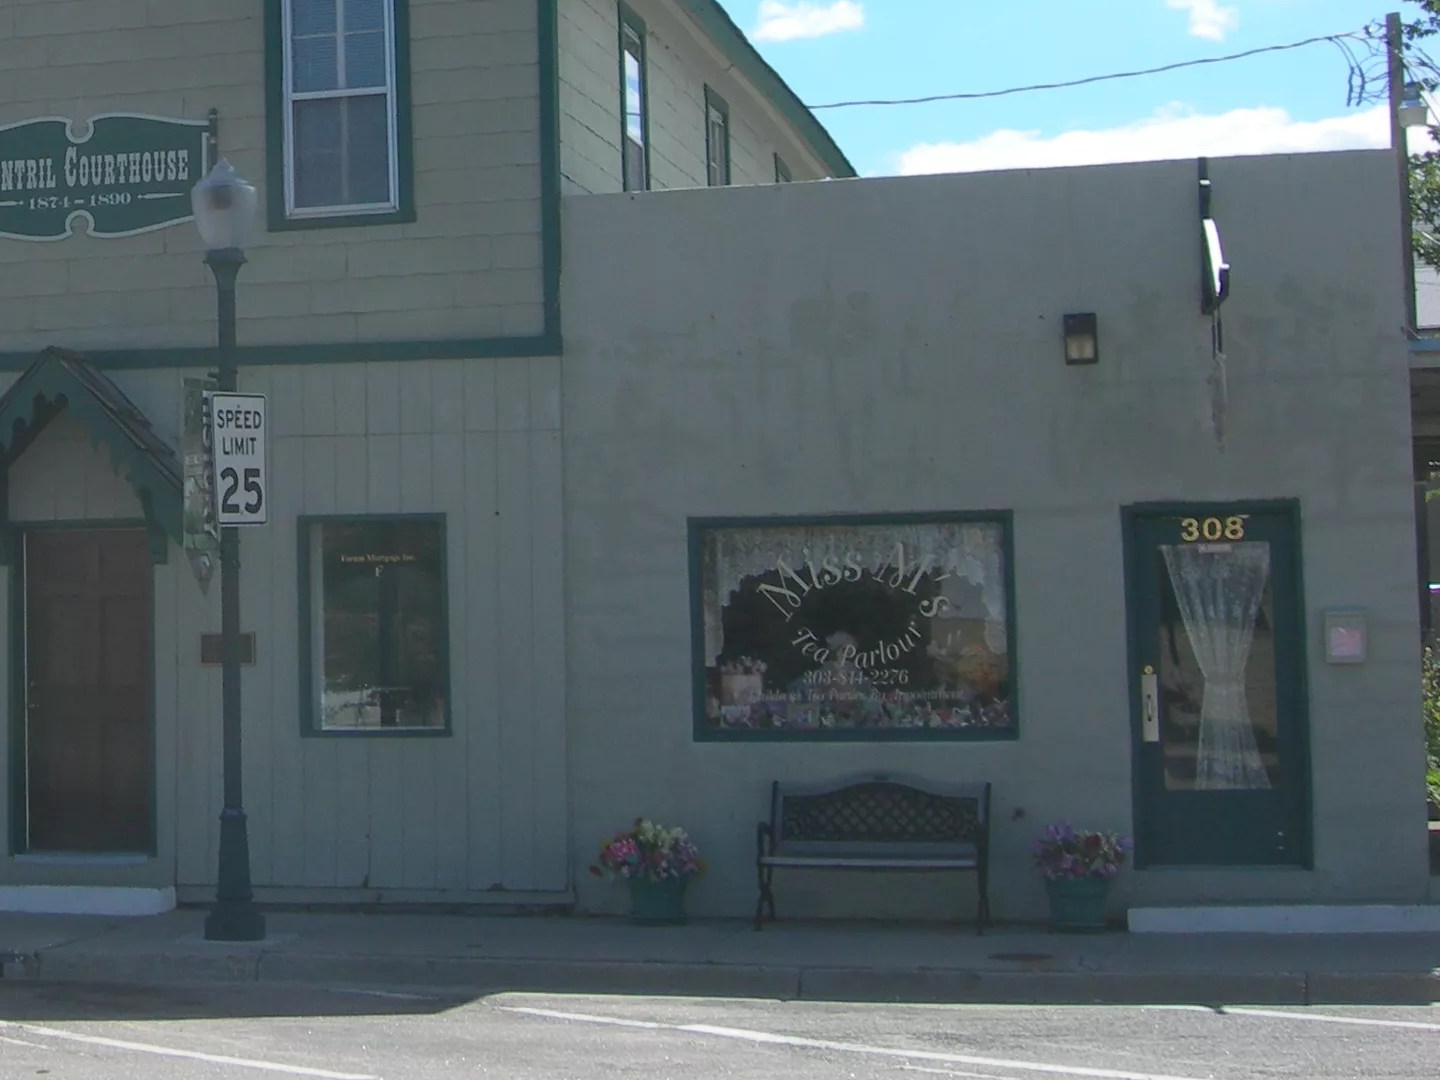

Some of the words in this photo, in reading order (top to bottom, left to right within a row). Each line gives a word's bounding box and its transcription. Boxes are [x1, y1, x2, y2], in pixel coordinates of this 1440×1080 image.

[64, 146, 189, 188] COURTHOUSE
[89, 191, 132, 207] 1890
[217, 410, 262, 428] SPEED
[223, 438, 256, 455] LIMIT
[220, 466, 263, 515] 25
[1180, 516, 1245, 542] 308
[756, 547, 862, 623] Miss
[792, 626, 830, 664] Tea
[840, 621, 922, 669] Parlour
